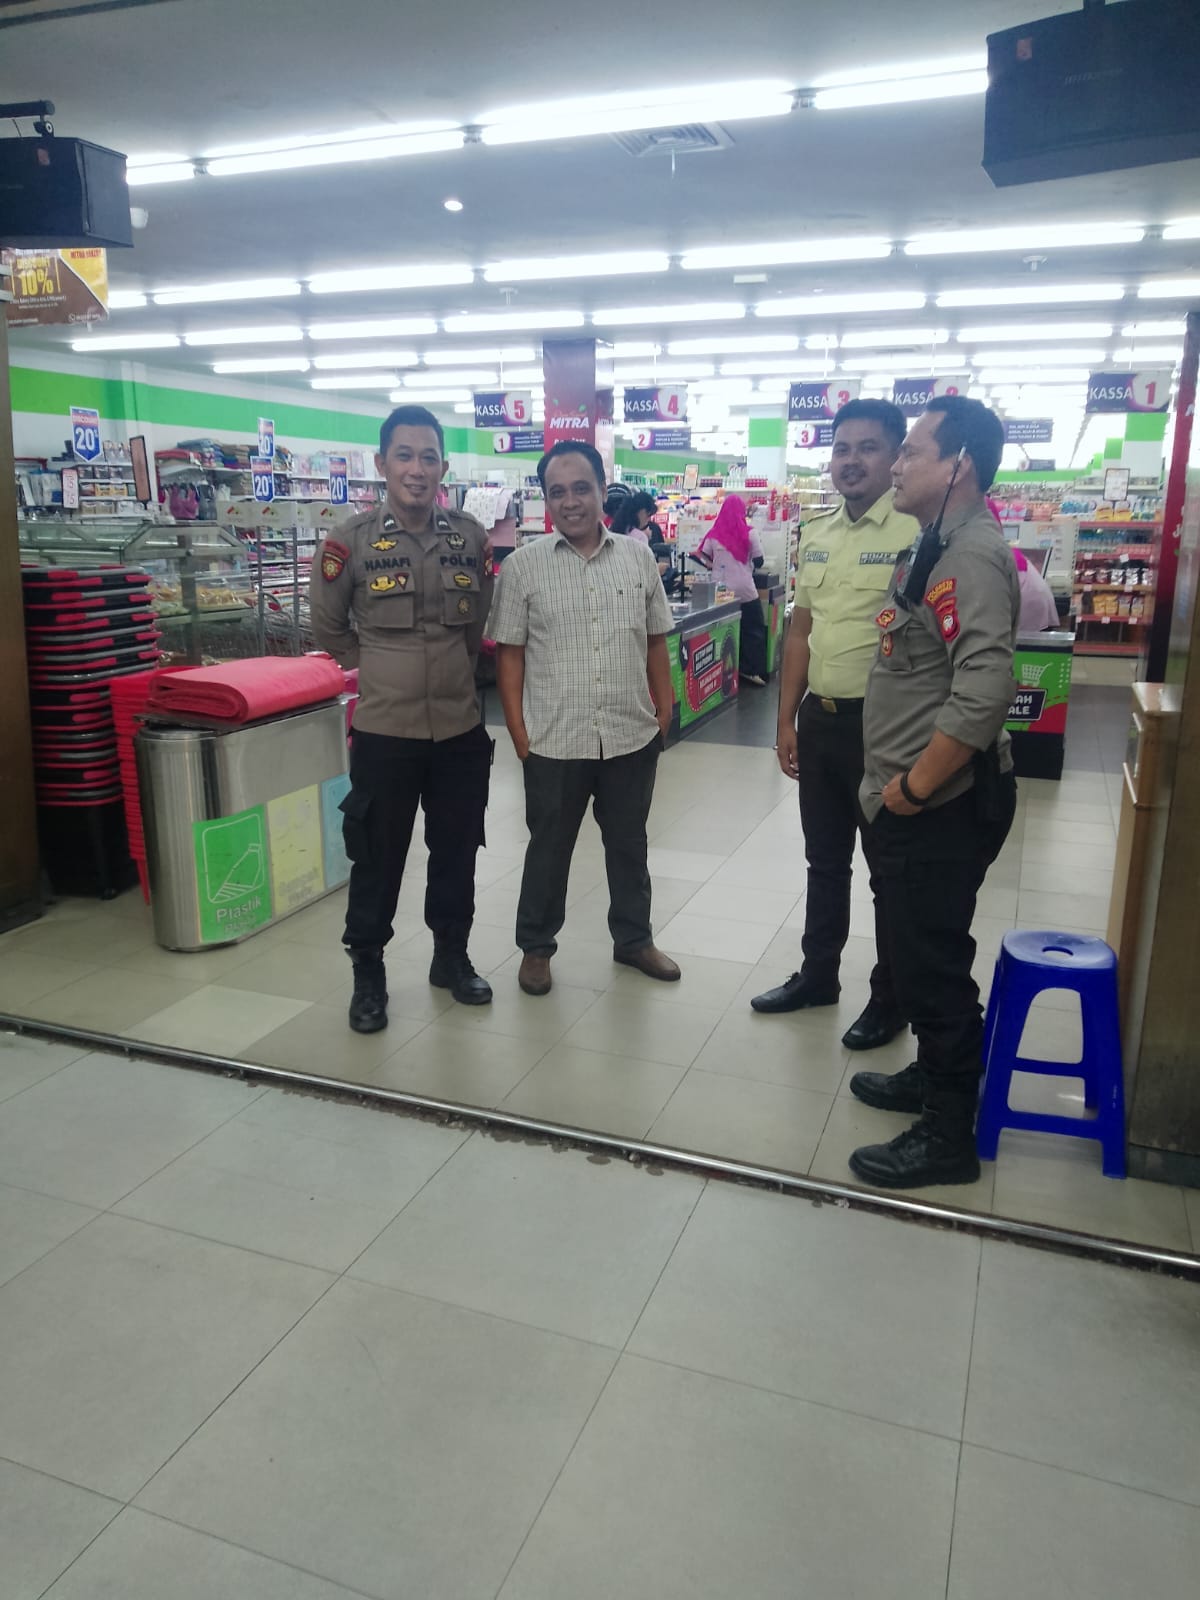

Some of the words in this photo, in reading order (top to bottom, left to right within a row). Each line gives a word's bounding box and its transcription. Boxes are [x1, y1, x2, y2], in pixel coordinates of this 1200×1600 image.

[18, 268, 54, 296] 10%
[791, 395, 828, 409] KASSA
[837, 390, 850, 410] 3
[895, 391, 934, 406] KASSA
[1089, 386, 1133, 400] KASSA
[1145, 381, 1156, 405] 1
[475, 404, 507, 417] KASSA
[514, 400, 525, 419] 5
[625, 400, 659, 412] KASSA
[668, 395, 679, 415] 4
[549, 416, 589, 429] MITRA
[498, 437, 504, 449] 1
[638, 433, 645, 447] 2
[801, 430, 809, 443] 3
[364, 556, 411, 571] HANAFI
[440, 553, 477, 568] POLRI
[1015, 695, 1033, 704] AH
[1007, 705, 1030, 715] ALE
[216, 895, 262, 923] Plastik
